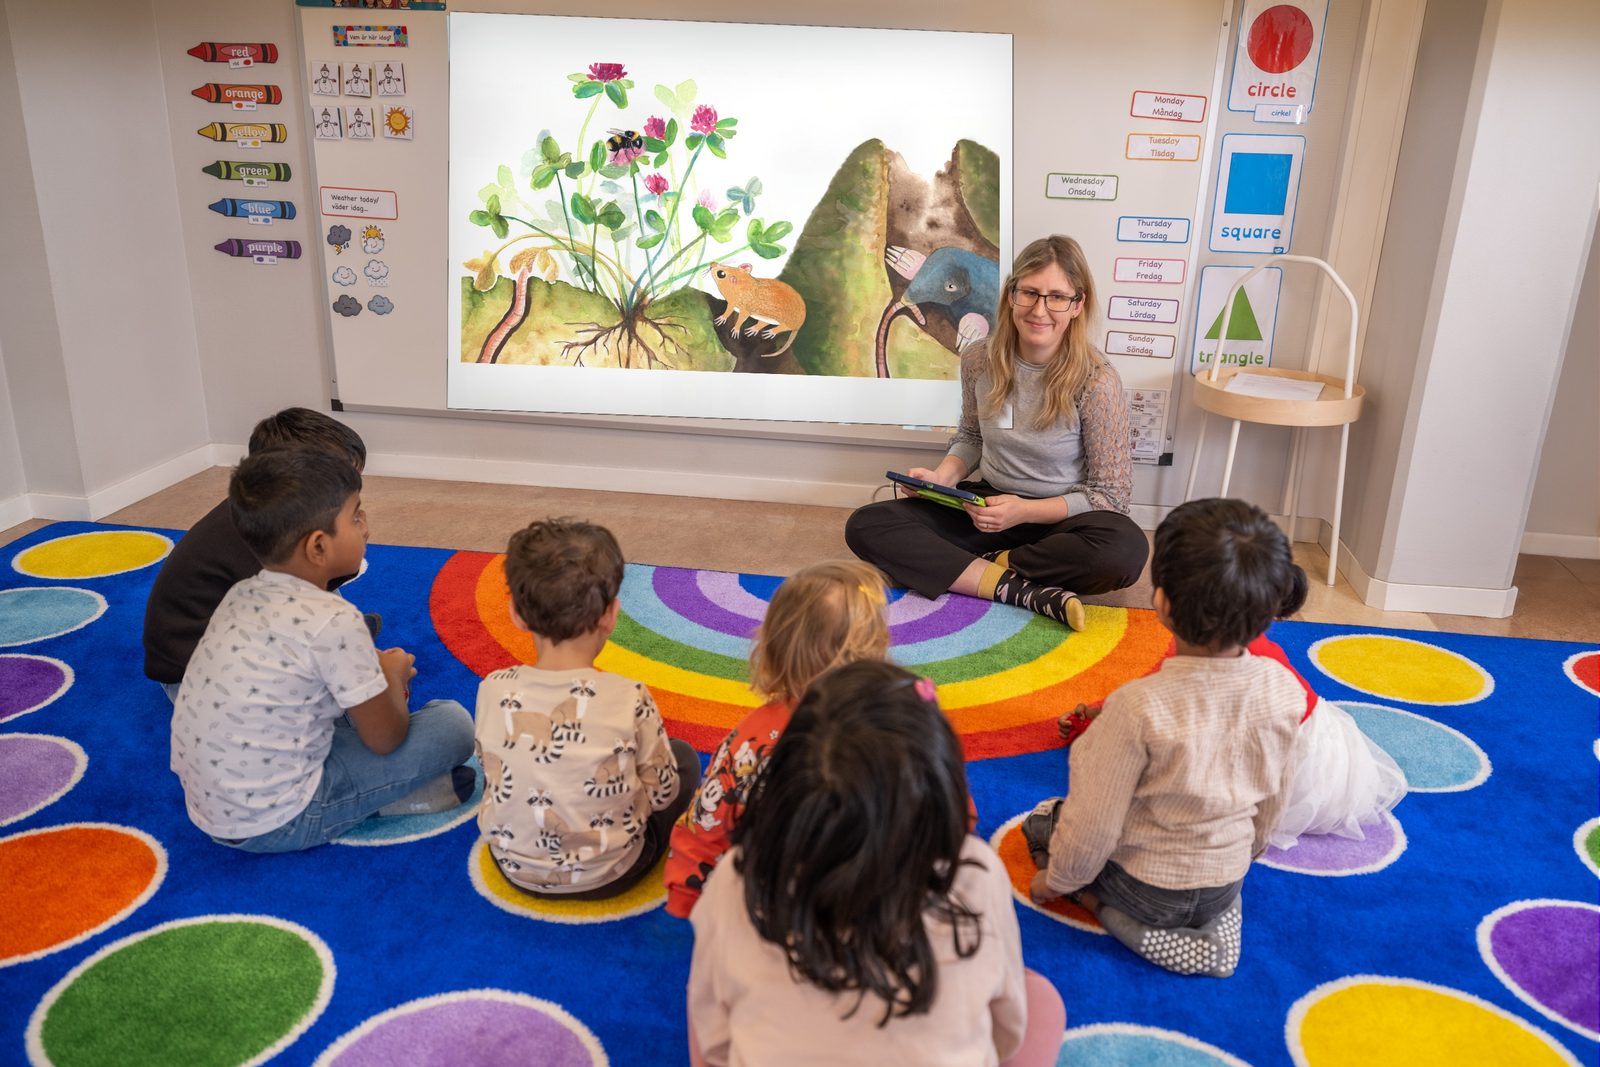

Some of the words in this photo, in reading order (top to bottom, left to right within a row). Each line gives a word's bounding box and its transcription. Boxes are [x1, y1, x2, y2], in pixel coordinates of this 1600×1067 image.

[231, 46, 250, 57] red
[225, 89, 265, 102] orange
[1247, 82, 1297, 98] circle
[1154, 95, 1186, 107] Monday
[1152, 107, 1184, 120] Måndag
[232, 127, 268, 139] yellow
[1149, 136, 1181, 146] Tuesday
[1150, 149, 1176, 160] Tisdag
[239, 166, 270, 178] green
[1061, 175, 1105, 186] Wednesday
[1067, 187, 1097, 198] Onsdag
[330, 194, 358, 202] Weather
[359, 195, 380, 205] today/
[248, 203, 272, 214] blue
[1137, 219, 1173, 229] Thursday
[1138, 231, 1168, 242] Torsdag
[1220, 226, 1282, 241] square
[247, 242, 283, 255] purple
[1138, 260, 1164, 270] Friday
[1136, 272, 1163, 282] Fredag
[1127, 299, 1162, 310] Saturday
[1129, 311, 1157, 322] Lördag
[1128, 334, 1155, 345] Sunday
[1126, 346, 1154, 357] Söndag
[1198, 350, 1265, 367] trangle
